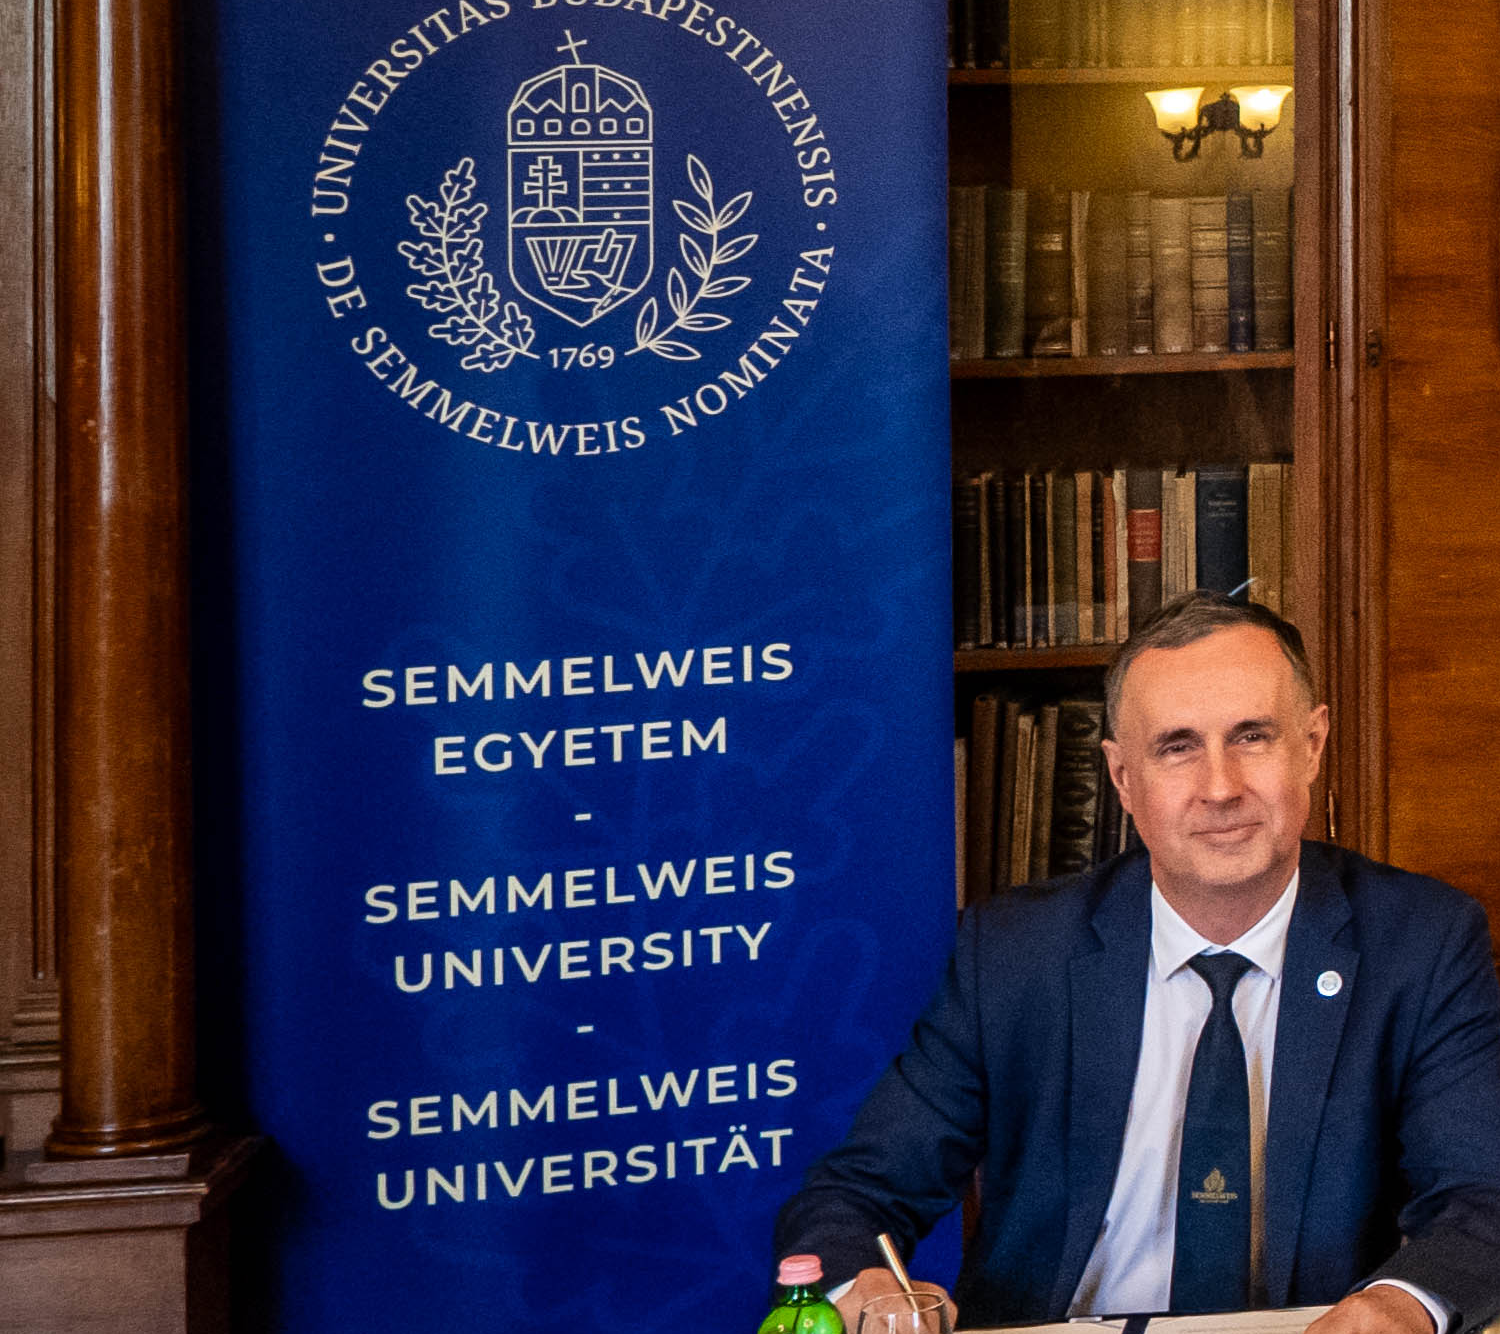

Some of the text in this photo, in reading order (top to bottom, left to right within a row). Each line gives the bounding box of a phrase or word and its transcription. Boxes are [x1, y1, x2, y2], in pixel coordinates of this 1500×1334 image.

[317, 244, 835, 456] DE SEMMELWEIS NOMINATA
[548, 345, 615, 370] 1769
[361, 643, 794, 708] SEMMELWEIS
[434, 718, 729, 775] EGYETEM
[365, 851, 796, 923] SEMMELWEIS
[395, 923, 772, 993] UNIVERSITY
[367, 1059, 798, 1139] SEMMELWEIS
[377, 1124, 793, 1210] UNIVERSITÄT
